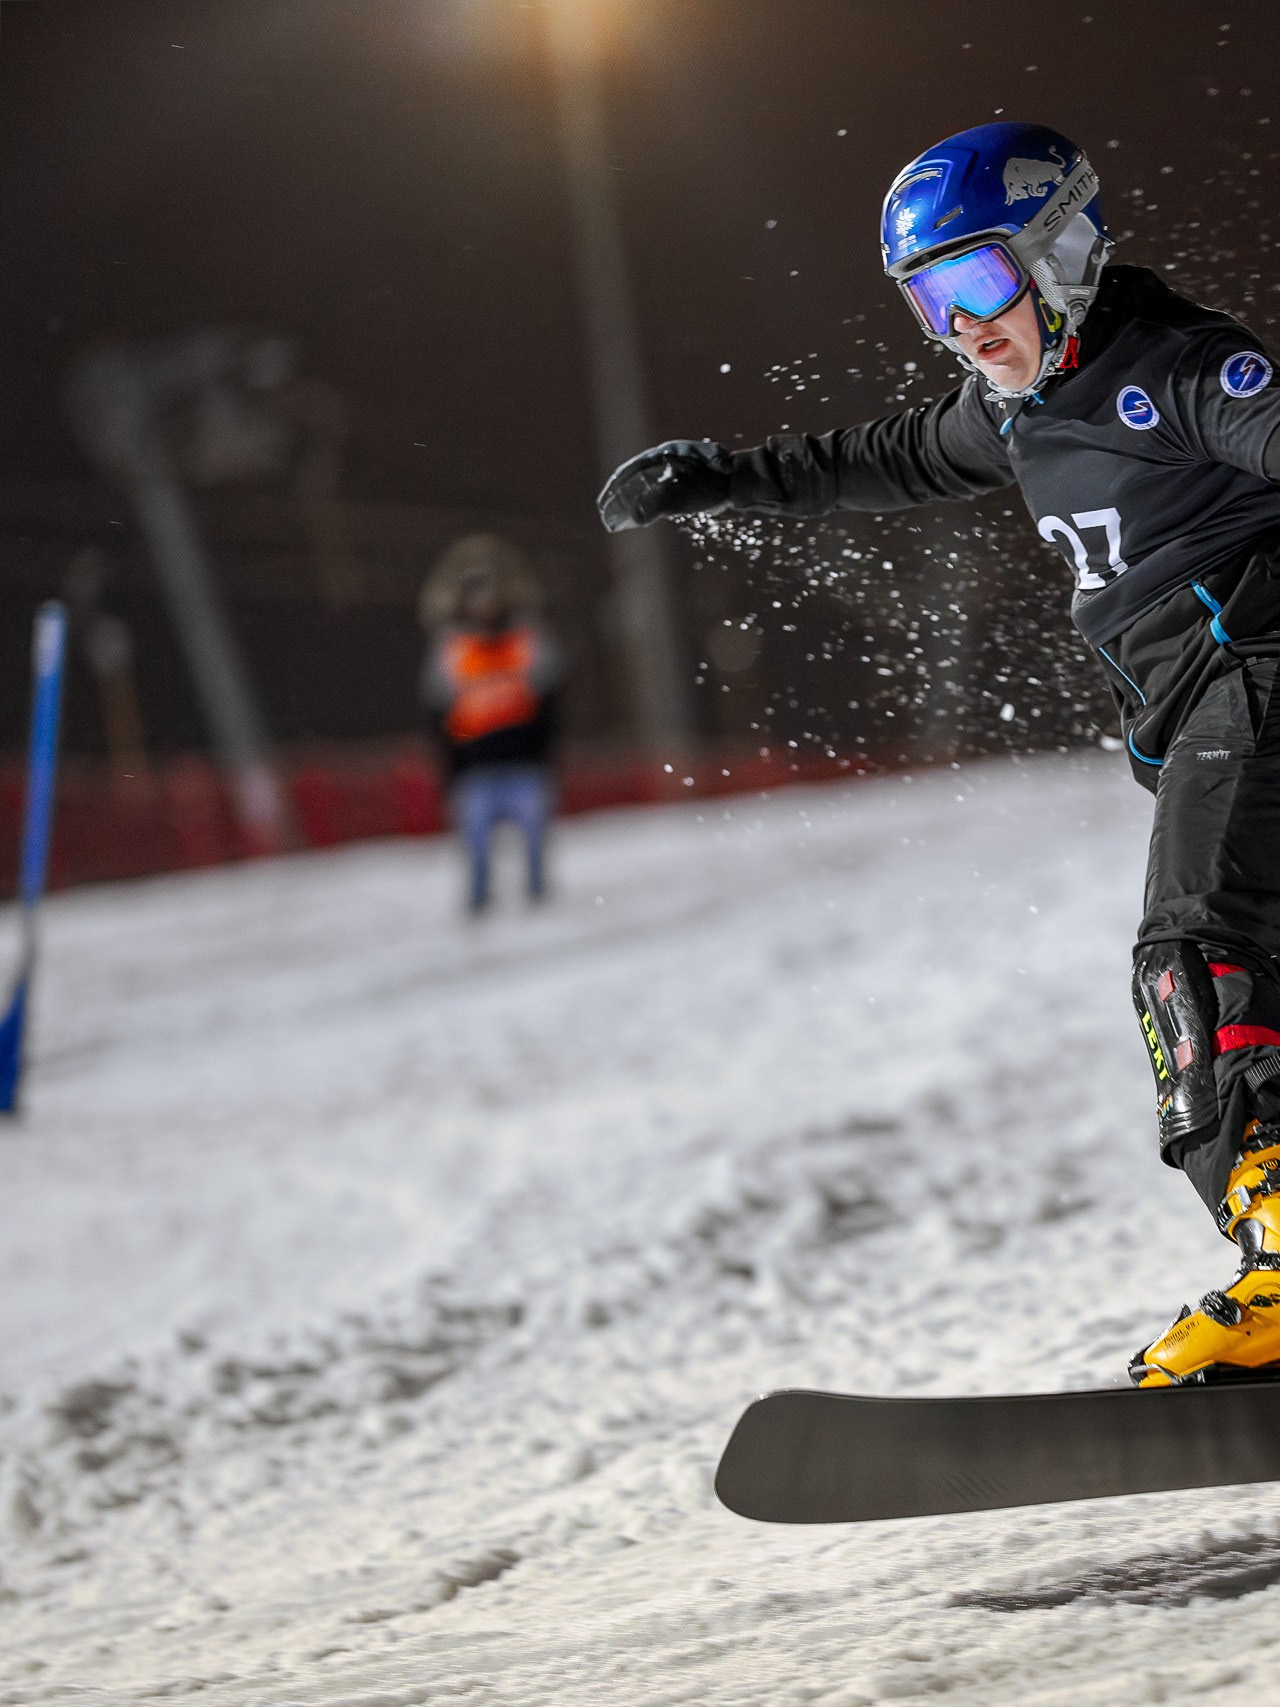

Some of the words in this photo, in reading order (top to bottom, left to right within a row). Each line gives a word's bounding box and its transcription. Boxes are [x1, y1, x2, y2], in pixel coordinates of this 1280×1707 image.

[1043, 170, 1097, 232] SMITH
[1037, 507, 1129, 590] 27
[1142, 1010, 1168, 1081] LEKI
